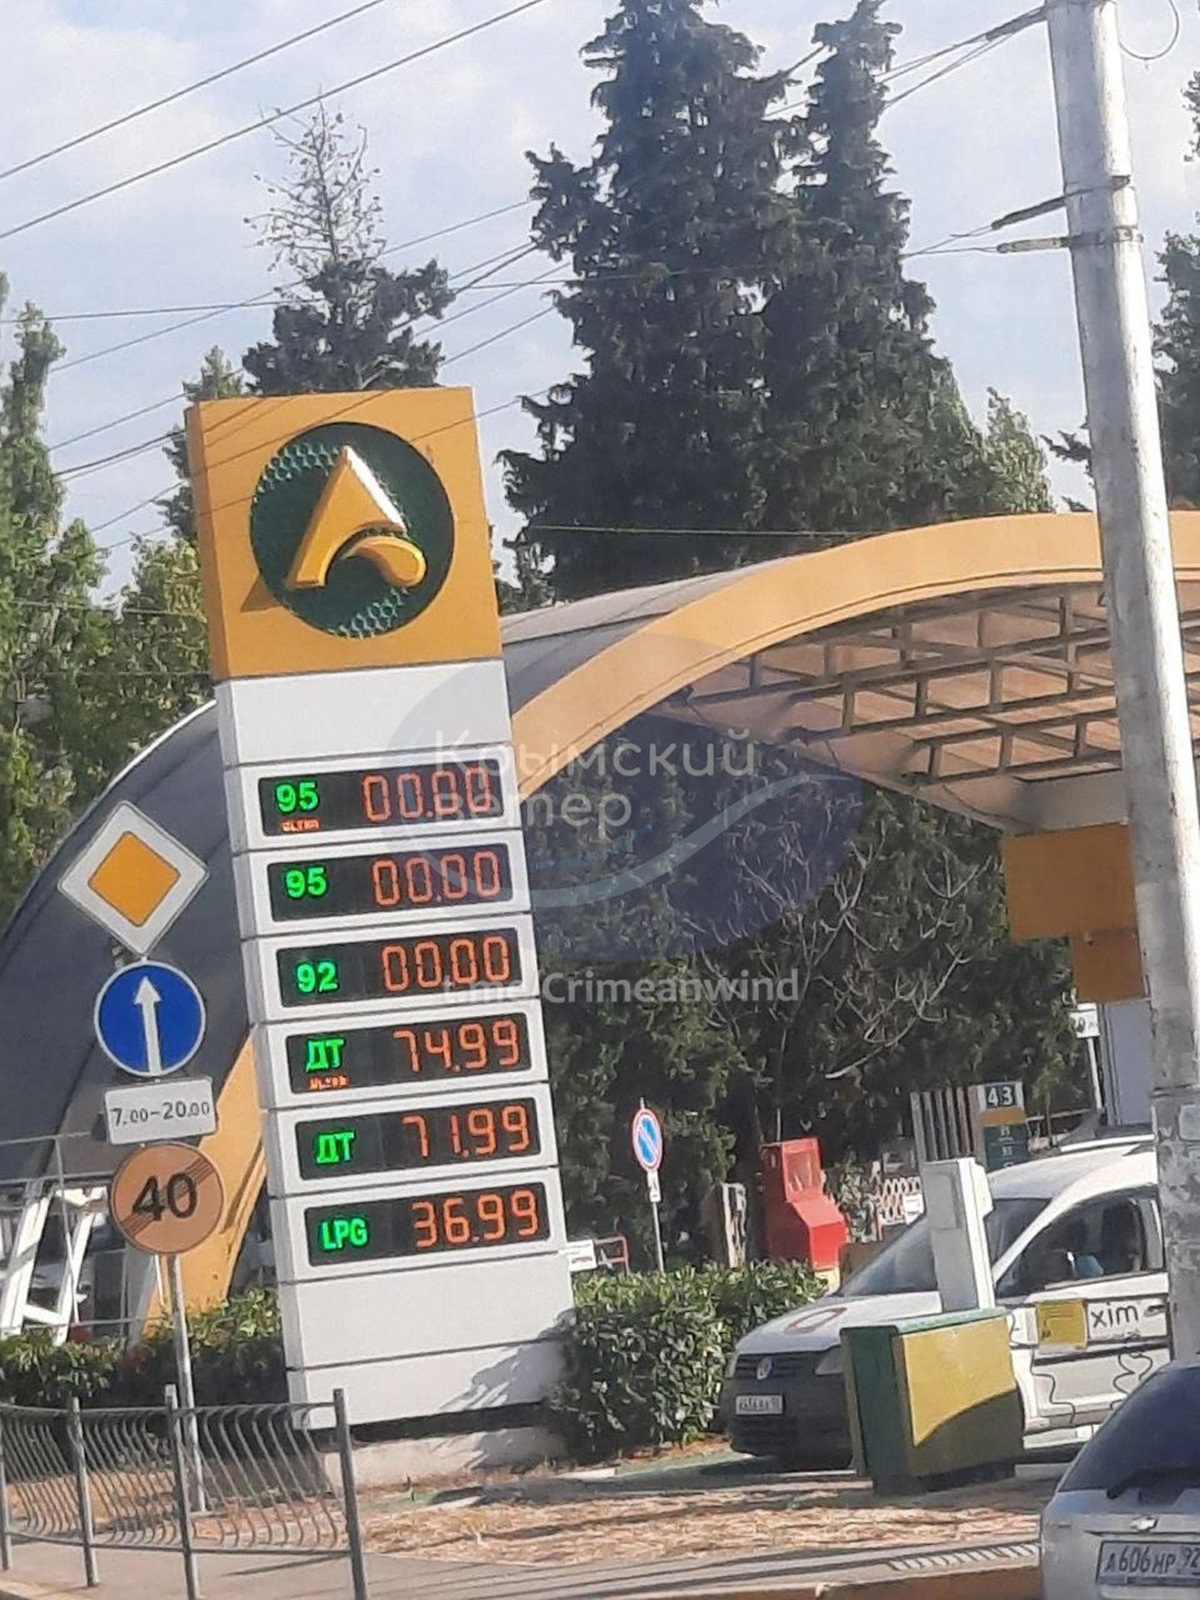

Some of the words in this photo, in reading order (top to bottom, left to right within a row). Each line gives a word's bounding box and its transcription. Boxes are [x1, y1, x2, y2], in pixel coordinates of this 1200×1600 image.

[276, 781, 319, 813] 95
[362, 766, 491, 822] 00.00
[285, 866, 328, 898] 95
[297, 962, 338, 993] 92
[305, 1038, 344, 1072] ДТ
[393, 1019, 520, 1073] 74.99
[110, 1101, 210, 1126] 7.00-20.00
[987, 1086, 1014, 1107] 43
[315, 1131, 355, 1164] ДТ
[403, 1104, 530, 1158] 71.99
[132, 1172, 198, 1221] 40
[321, 1218, 368, 1251] LPG
[412, 1189, 539, 1248] 36.99
